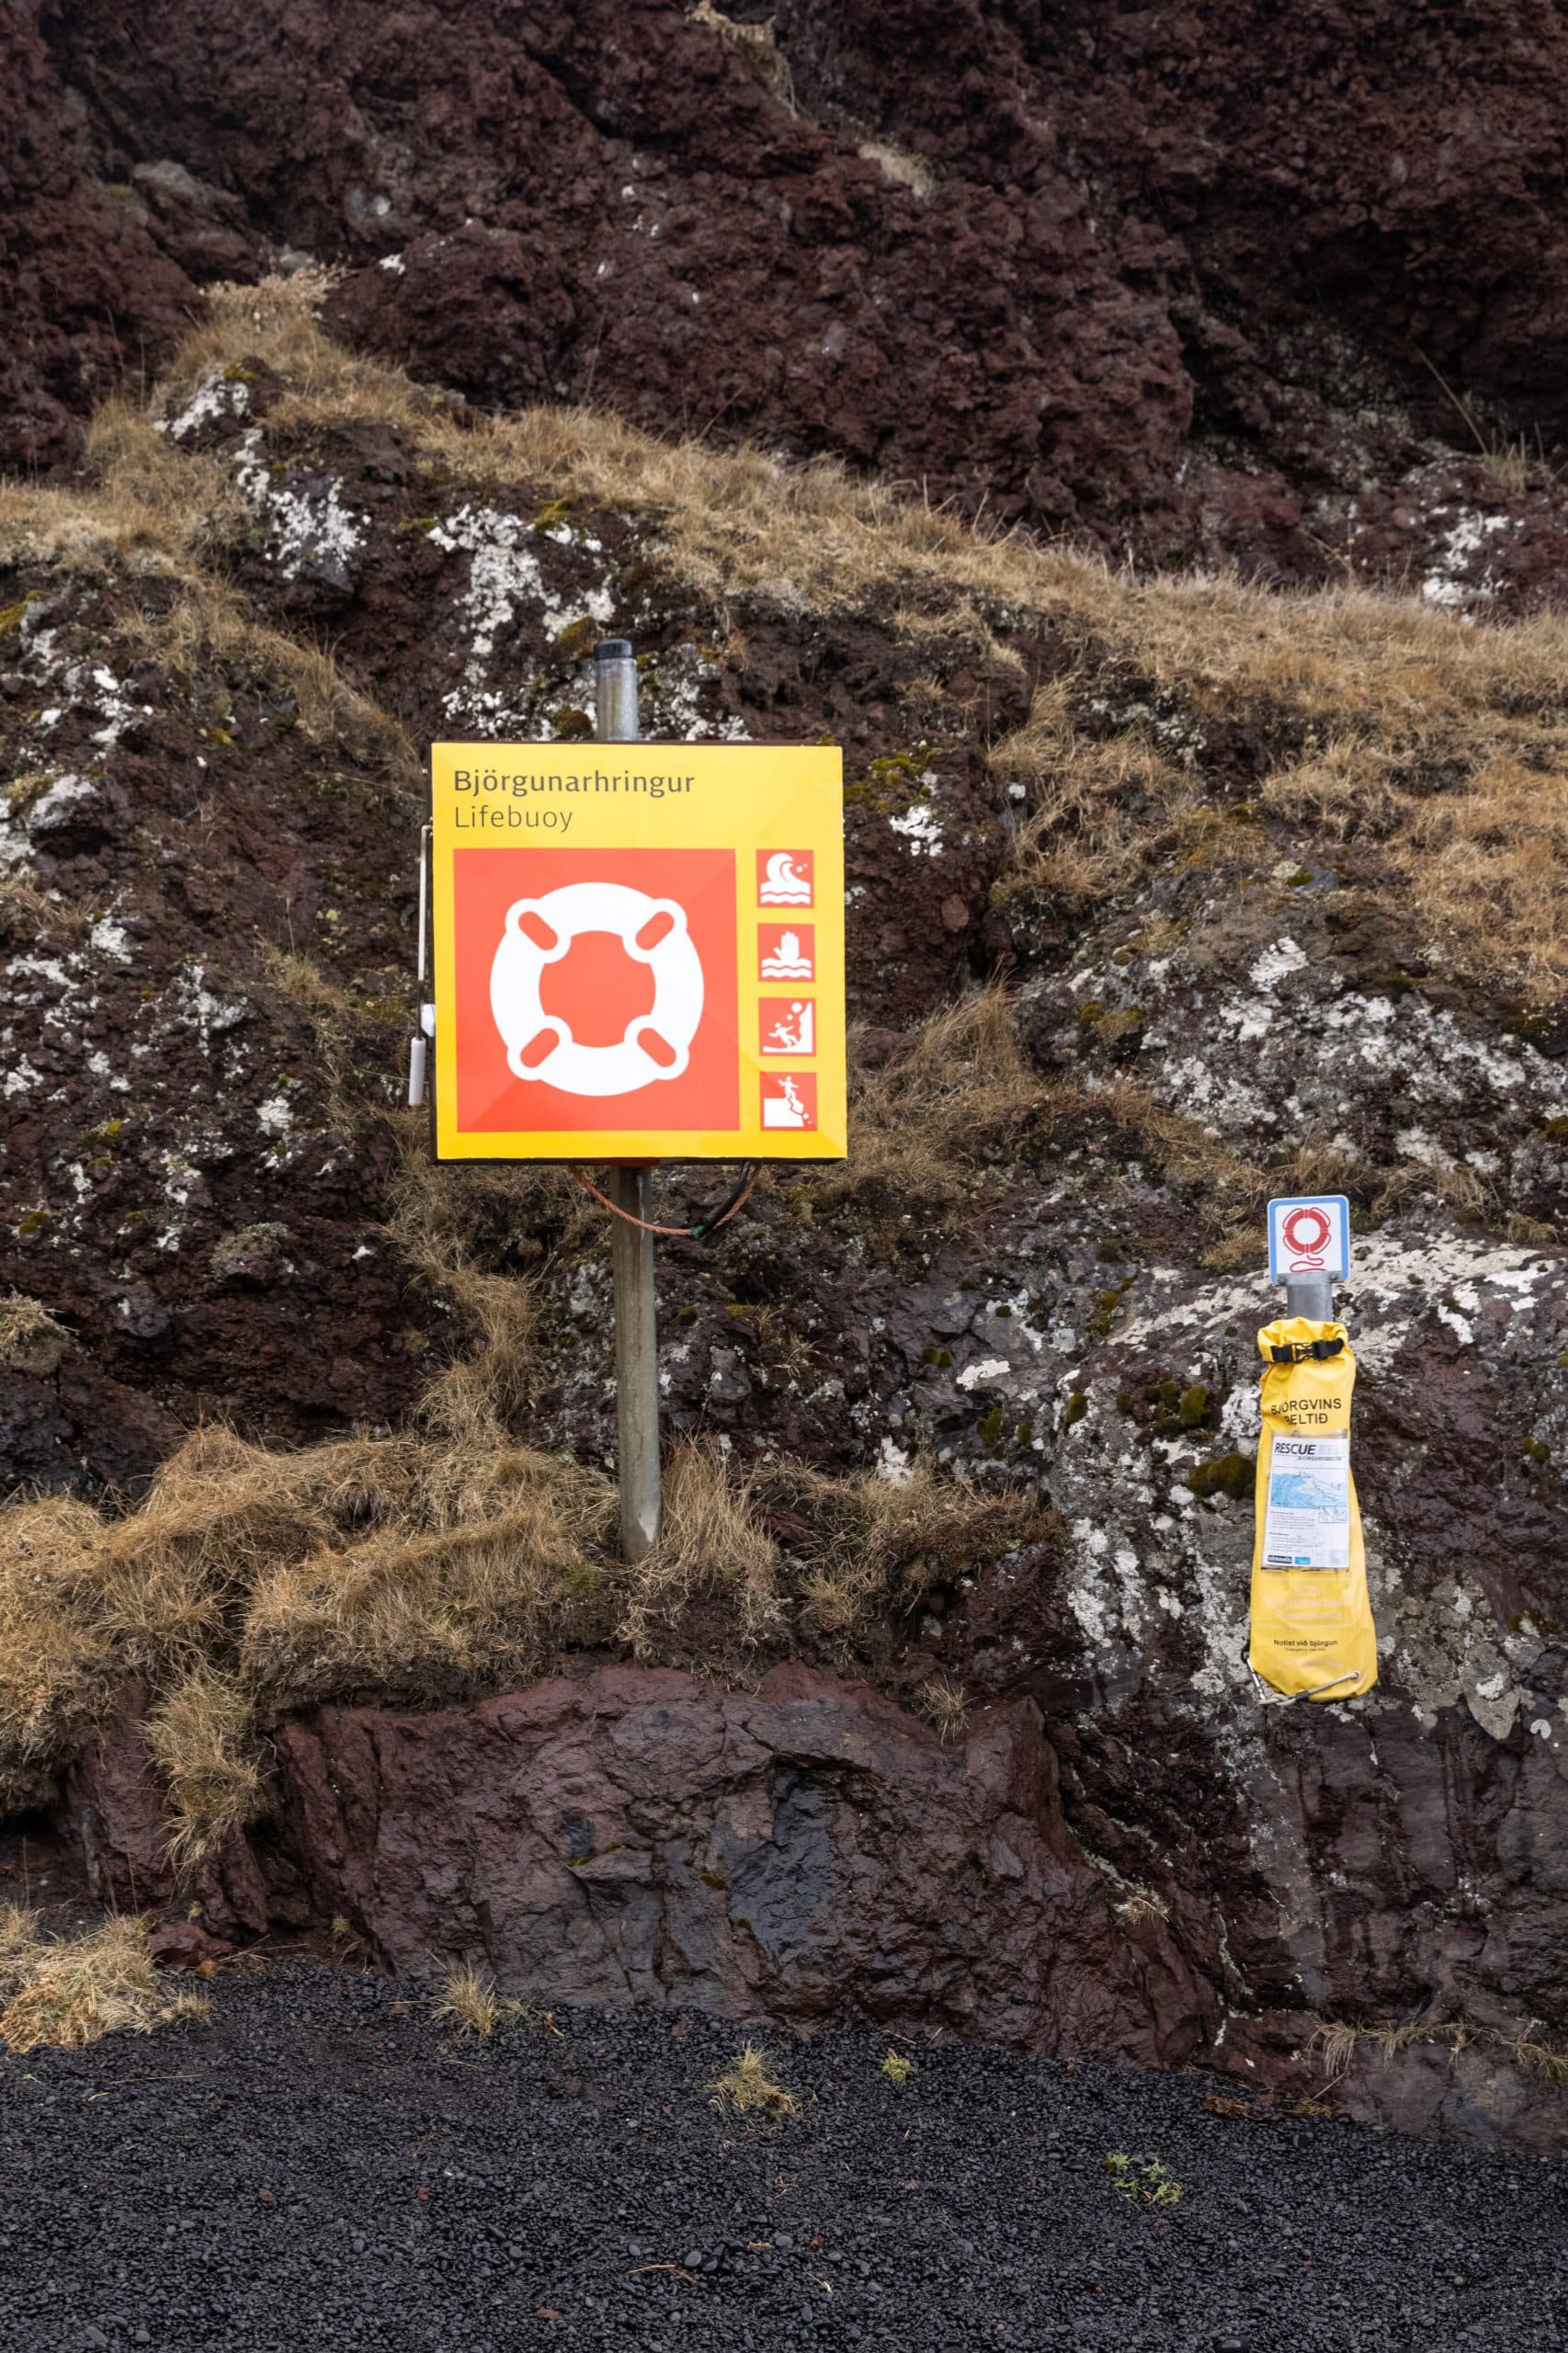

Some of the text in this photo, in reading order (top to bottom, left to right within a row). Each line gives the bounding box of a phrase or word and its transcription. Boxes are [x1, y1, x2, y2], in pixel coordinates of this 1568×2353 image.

[454, 769, 695, 798] Björgunarhringur
[455, 804, 573, 833] Lifebuoy
[1274, 1442, 1316, 1455] RESCUE
